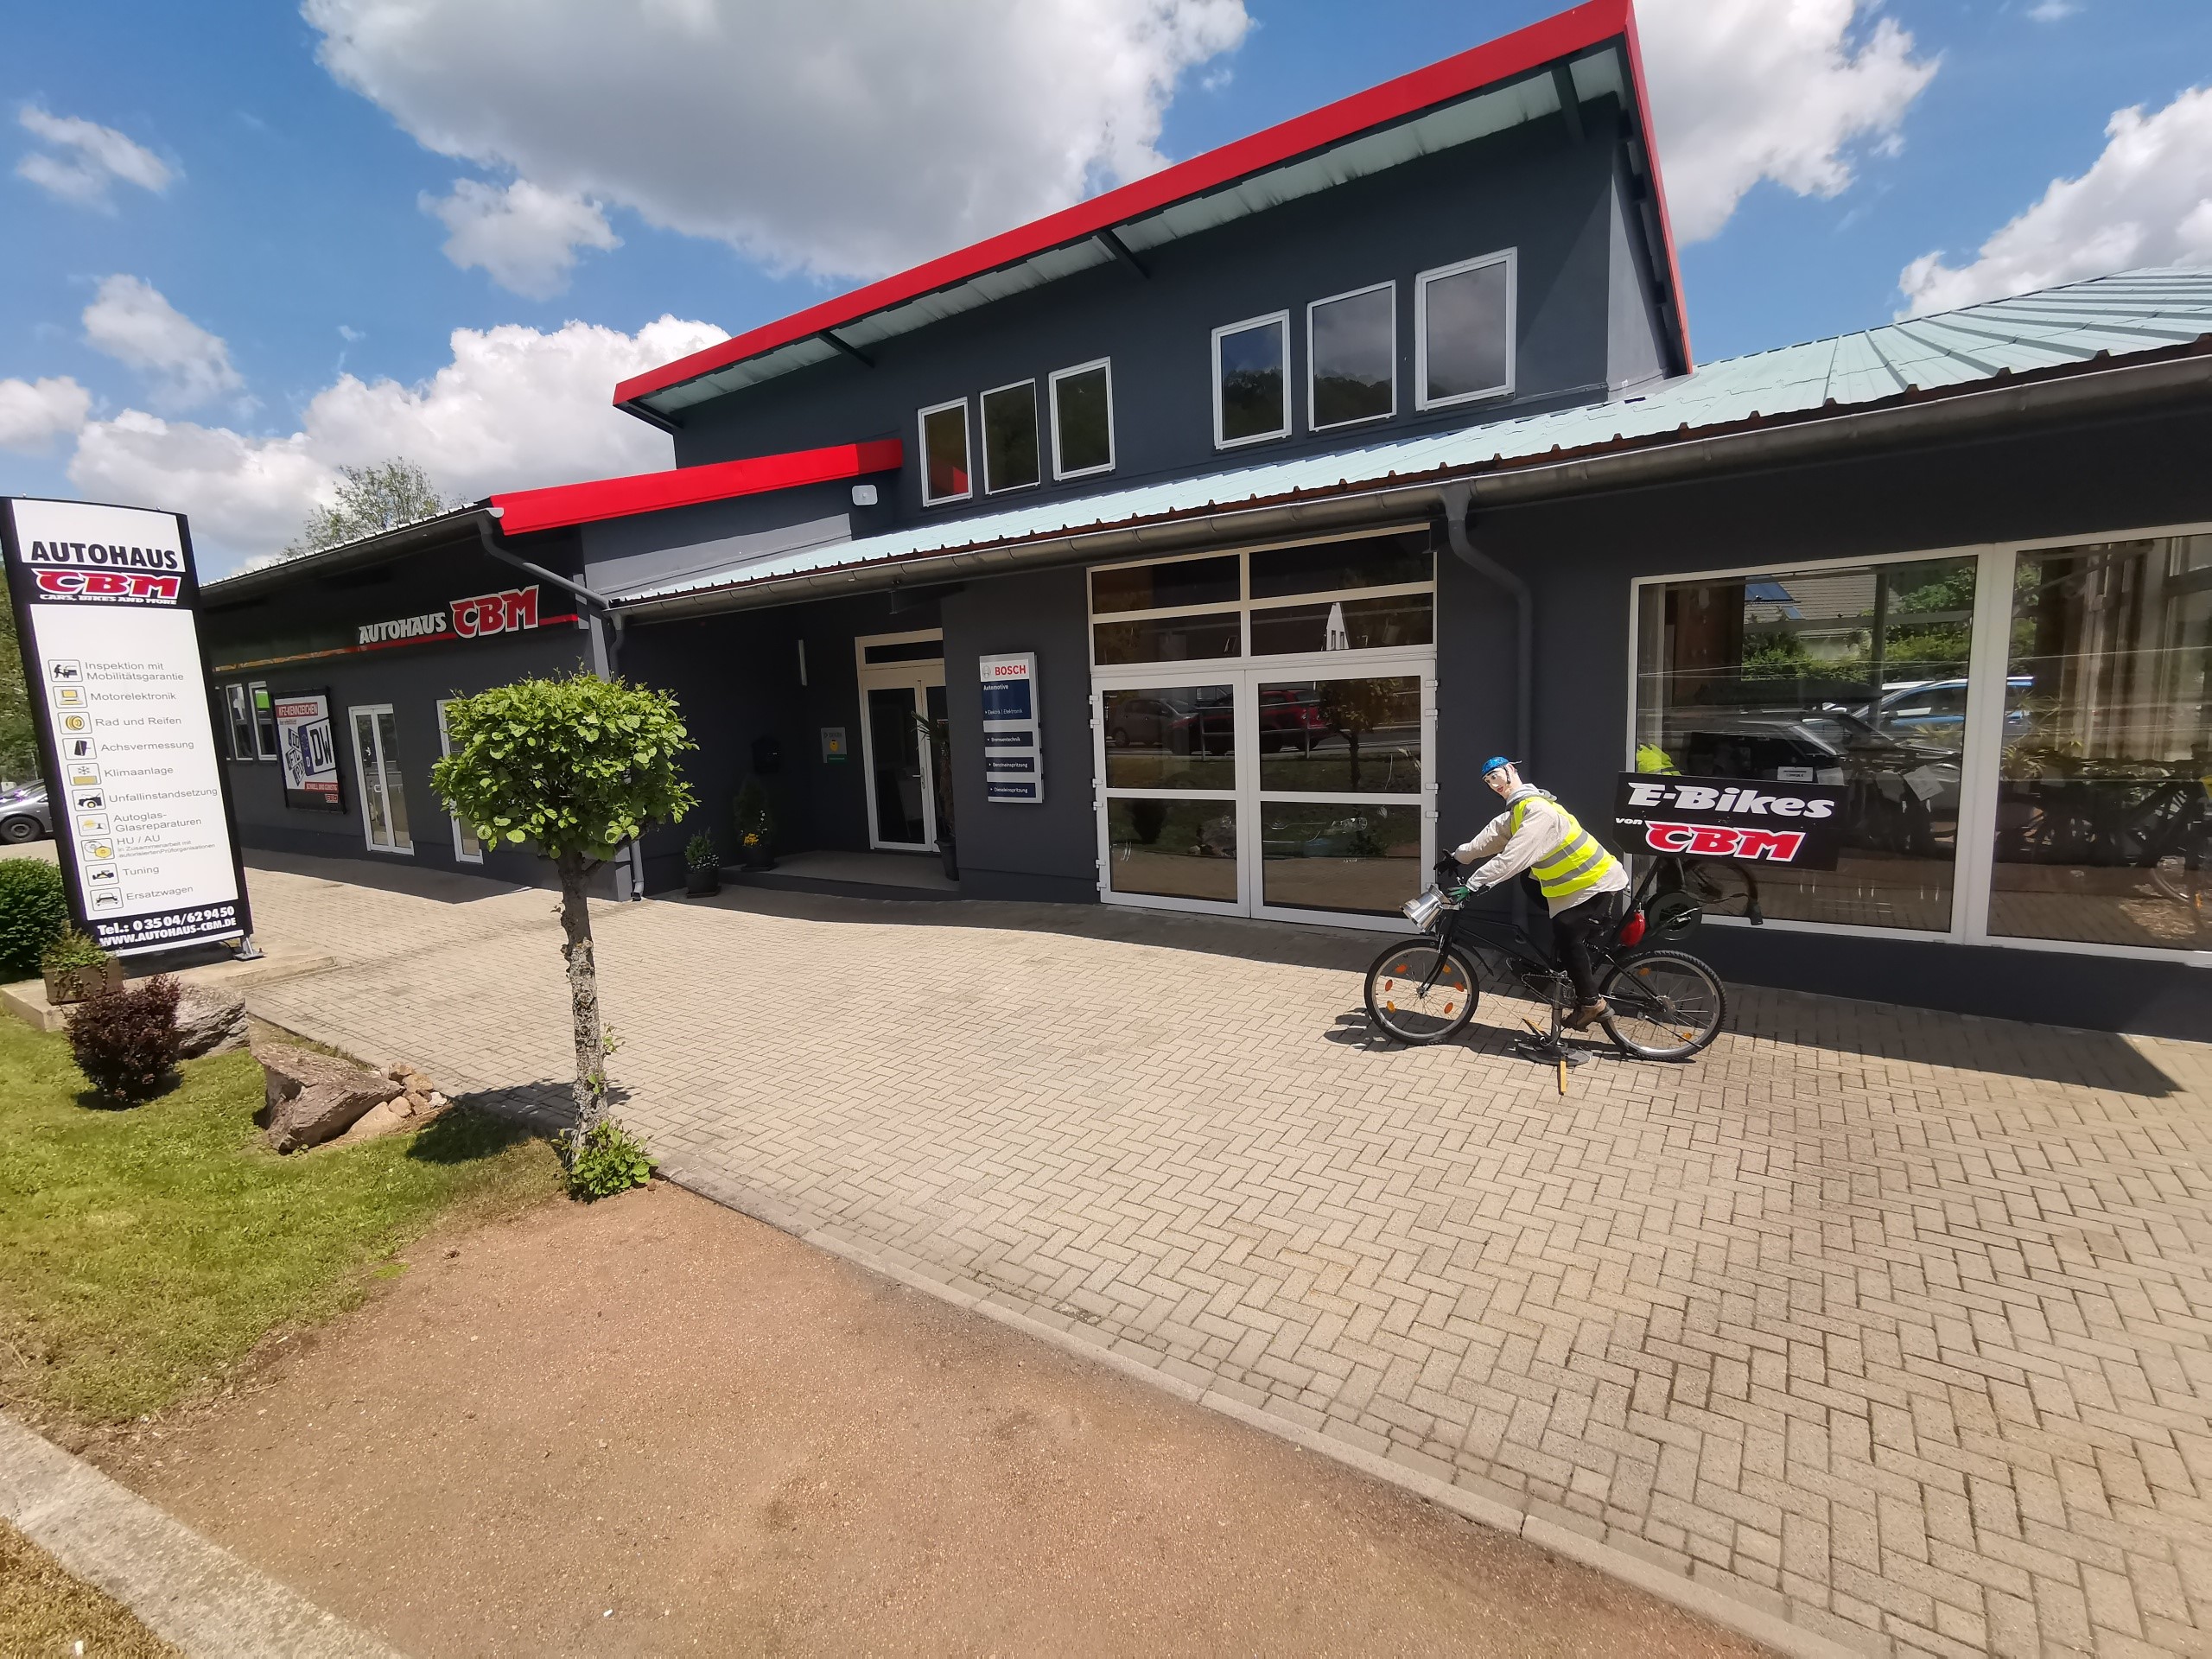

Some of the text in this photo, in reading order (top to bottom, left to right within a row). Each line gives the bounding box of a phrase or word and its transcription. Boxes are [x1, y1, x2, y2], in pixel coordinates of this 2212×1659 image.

[31, 541, 177, 569] AUTOHAUS
[31, 569, 181, 599] CBM
[359, 584, 539, 645] AUTOHAUS CBM
[86, 662, 144, 671] Inspektion
[995, 664, 1027, 676] BOSCH
[86, 672, 184, 682] Mobilitätsgarantie
[95, 718, 119, 727] Rad
[148, 716, 182, 725] Reifen
[100, 741, 194, 752] Achsvermessung
[104, 766, 174, 777] Klimaanlage
[109, 788, 218, 803] Unfallinstandsetzung
[1628, 782, 1834, 818] E-Bikes
[113, 811, 168, 823] Autoglas-
[115, 818, 202, 832] Glasreparaturen
[117, 836, 134, 845] HU
[125, 842, 181, 852] Zusammenarbeit
[1644, 820, 1806, 862] CBM
[123, 866, 160, 876] Tuning
[126, 886, 194, 900] Ersatzwagen
[97, 922, 130, 936] Tel.:
[99, 918, 237, 947] WWW.AUTOHAUS-CBM.DE
